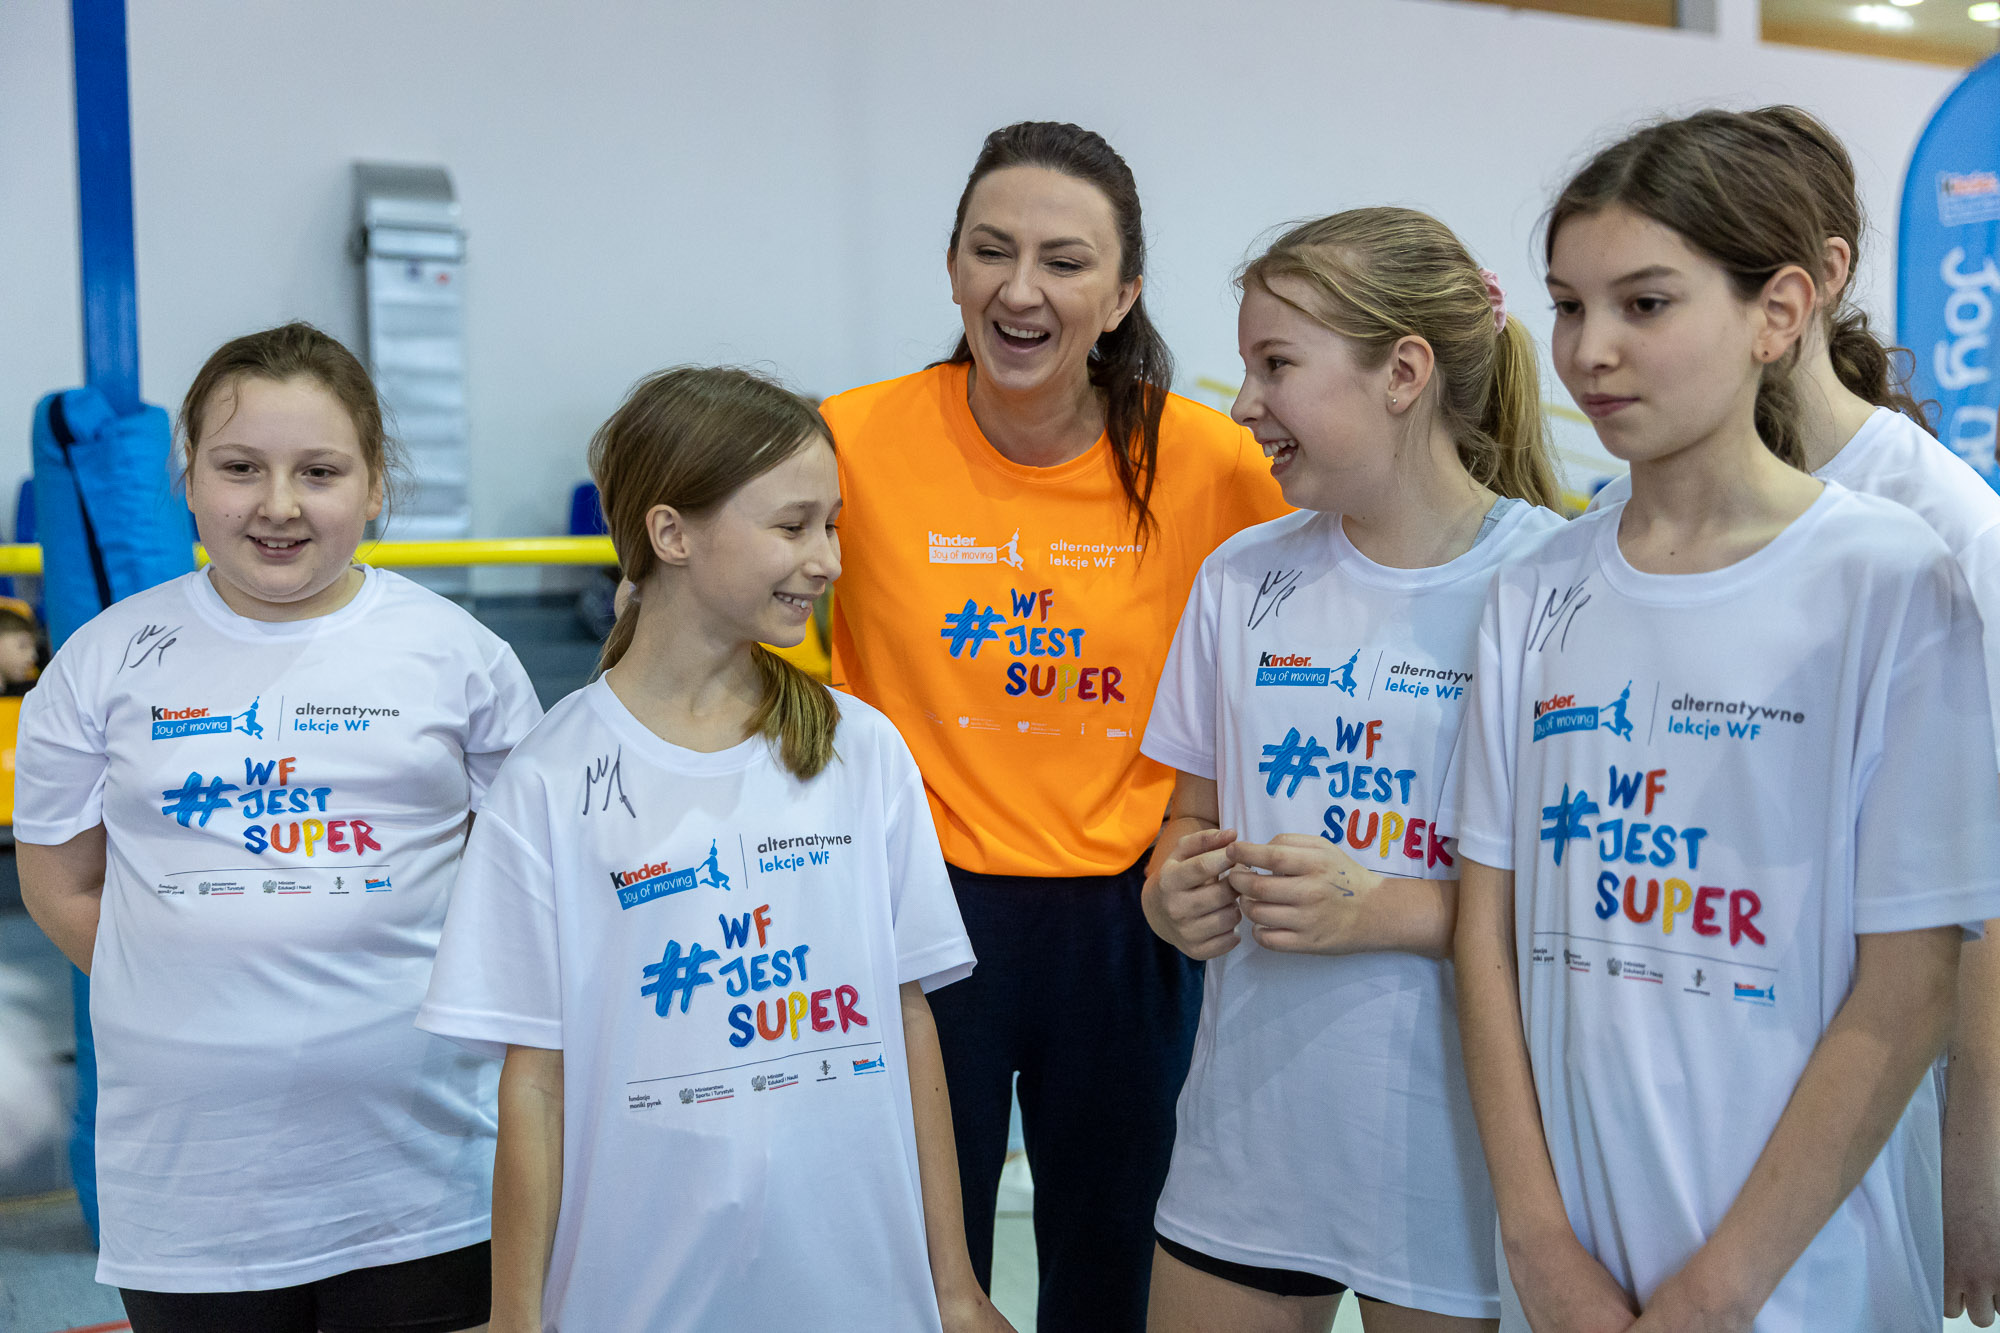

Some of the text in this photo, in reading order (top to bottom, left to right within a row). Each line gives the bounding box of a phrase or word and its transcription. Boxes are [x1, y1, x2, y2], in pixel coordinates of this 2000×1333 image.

[1933, 246, 2000, 391] Joy
[932, 549, 994, 562] Joy of moving
[1050, 539, 1142, 554] alternatywne
[1050, 554, 1116, 570] lekcje WF
[1010, 587, 1053, 623] WF
[1004, 624, 1086, 658] JEST
[1005, 662, 1126, 704] SUPER
[1259, 671, 1326, 684] Joy of moving
[1390, 661, 1473, 685] alternatyw
[1385, 677, 1463, 700] lekcje WF
[295, 703, 400, 717] alternatywne
[1556, 712, 1595, 728] moving
[1671, 693, 1805, 724] alternatywne
[154, 720, 228, 736] Joy of moving
[294, 719, 370, 735] lekcje WF
[1336, 716, 1383, 760] WF
[1668, 716, 1761, 741] lekcje WF
[244, 756, 296, 786] WF
[1326, 761, 1416, 804] JEST
[237, 787, 332, 818] JEST
[1608, 765, 1666, 816] WF
[243, 818, 381, 857] SUPER
[757, 833, 852, 854] alternatywne
[1596, 818, 1708, 869] JEST
[759, 850, 830, 873] lekcje WF
[623, 875, 693, 904] Joy of moving
[1595, 870, 1766, 947] SUPER
[718, 904, 771, 949] WF
[719, 944, 810, 997] JEST
[728, 984, 868, 1048] SUPER
